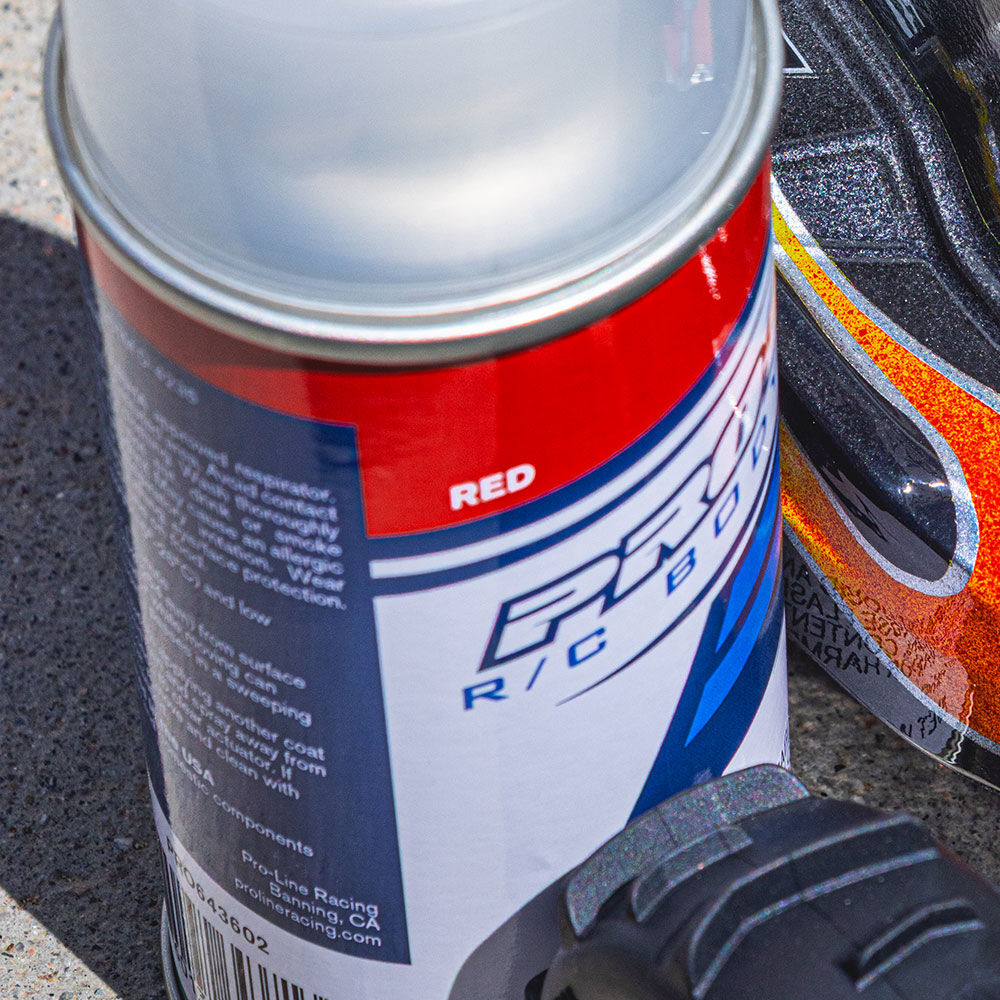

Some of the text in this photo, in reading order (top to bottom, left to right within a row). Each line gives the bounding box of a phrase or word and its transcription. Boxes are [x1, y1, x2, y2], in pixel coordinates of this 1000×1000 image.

[235, 462, 337, 505] respirator.
[261, 490, 339, 523] contact
[449, 463, 537, 511] RED
[234, 494, 341, 543] thoroughly
[241, 533, 267, 553] an
[269, 544, 345, 577] allergic
[273, 528, 343, 558] smoke
[242, 567, 347, 611] protection.
[286, 563, 346, 594] Wear
[238, 598, 273, 628] low
[238, 652, 307, 690] surface
[243, 671, 277, 697] can
[461, 626, 607, 711] R/C
[226, 677, 313, 729] sweeping
[215, 701, 279, 743] another
[282, 737, 327, 762] coat
[234, 729, 280, 763] away
[282, 750, 328, 778] from
[181, 745, 216, 788] USA
[215, 746, 260, 781] clean
[261, 773, 301, 801] with
[280, 763, 294, 781] If
[212, 793, 315, 858] components
[165, 835, 271, 956] PRO643602
[240, 848, 380, 919] Pro-Line Racing
[268, 881, 382, 932] Banning, CA
[234, 876, 383, 948] prolineracing.com
